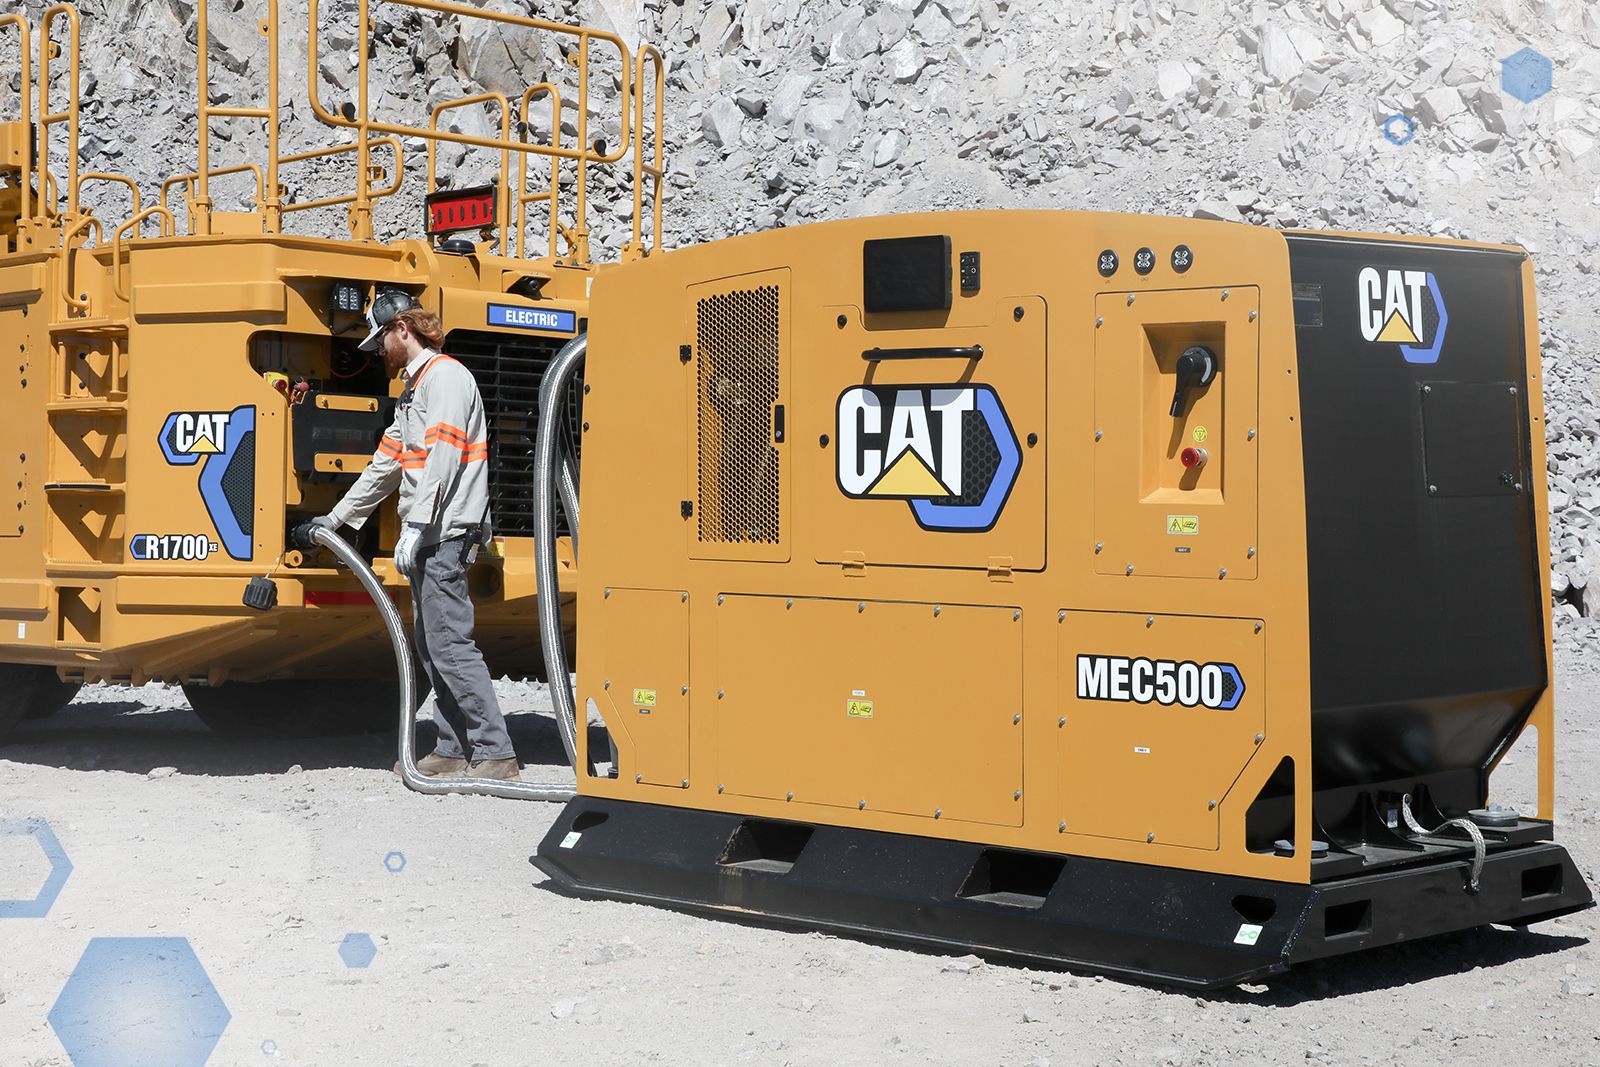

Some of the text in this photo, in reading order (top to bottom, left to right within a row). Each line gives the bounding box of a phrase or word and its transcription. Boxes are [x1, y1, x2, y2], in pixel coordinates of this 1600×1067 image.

[505, 309, 558, 327] ELECTRIC
[1358, 266, 1426, 343] CAT
[176, 413, 230, 453] CAT
[839, 388, 974, 497] CAT
[1078, 656, 1223, 708] MEC500
